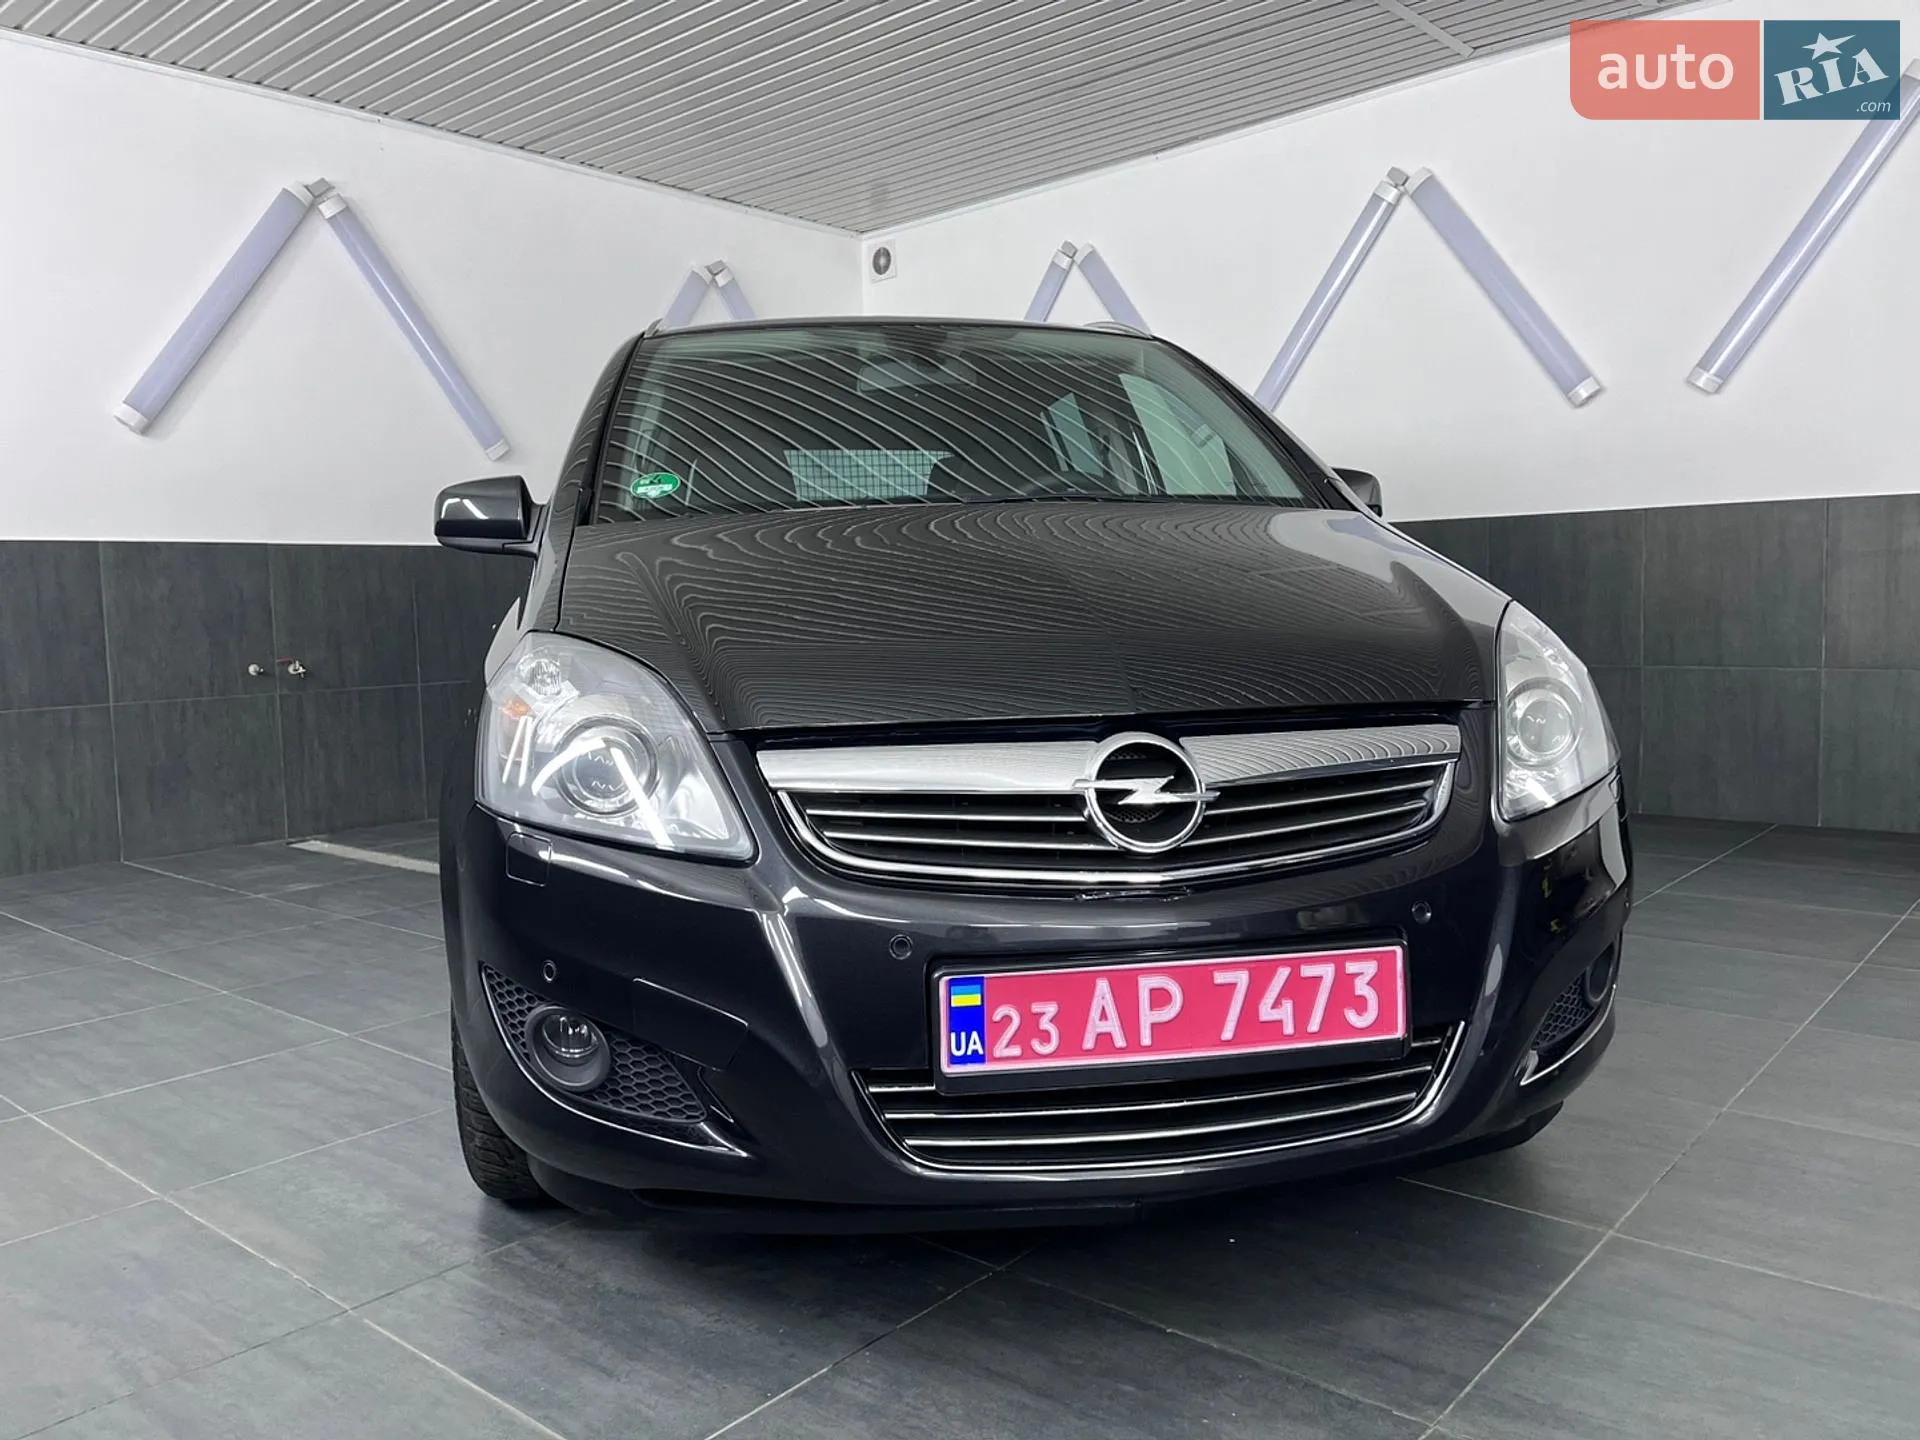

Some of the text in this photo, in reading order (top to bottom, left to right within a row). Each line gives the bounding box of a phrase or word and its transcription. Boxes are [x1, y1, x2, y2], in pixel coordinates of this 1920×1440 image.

[992, 960, 1379, 1058] 23 AP 7473
[950, 1031, 983, 1055] UA
